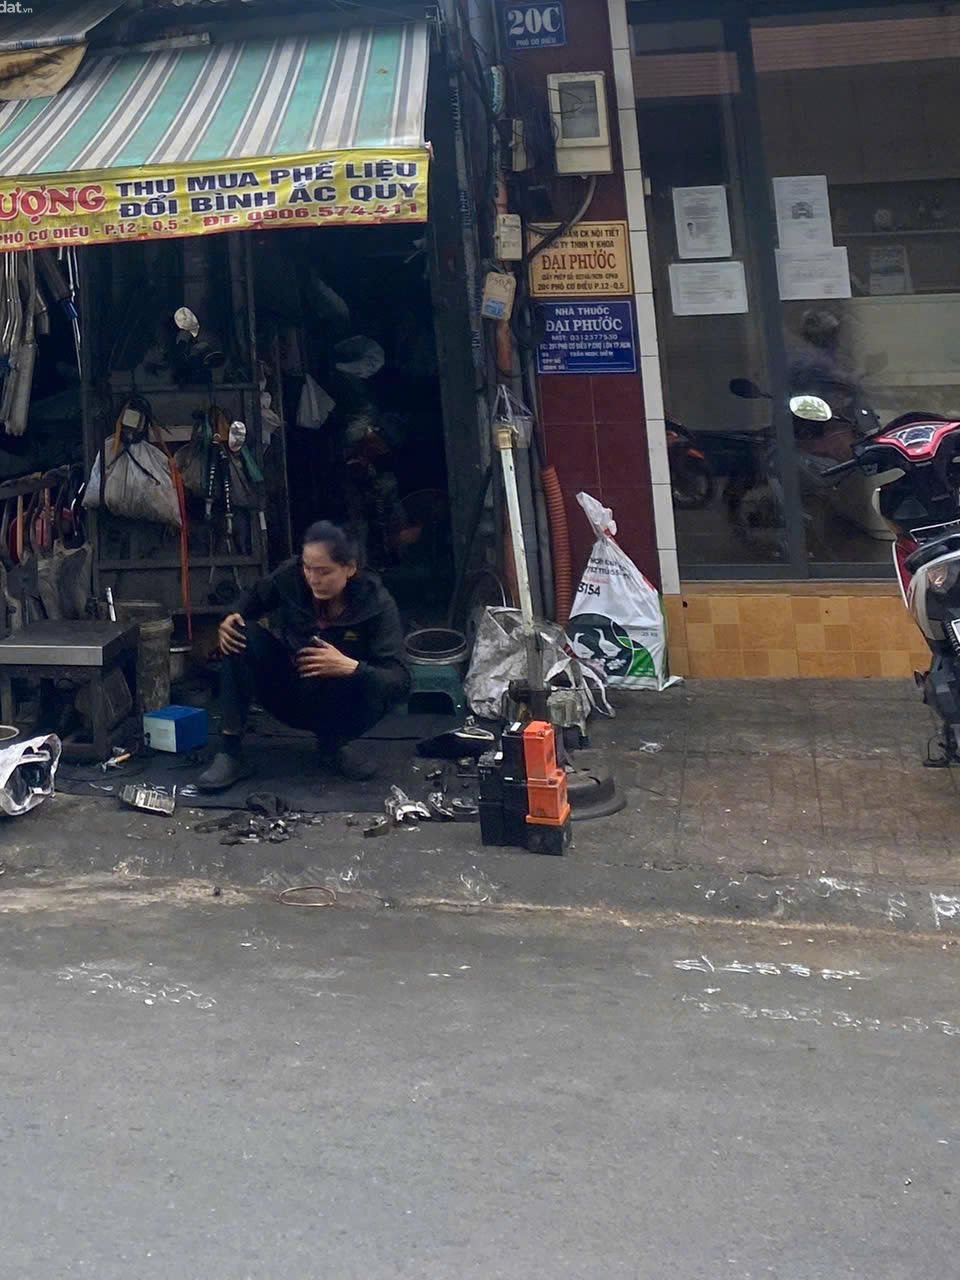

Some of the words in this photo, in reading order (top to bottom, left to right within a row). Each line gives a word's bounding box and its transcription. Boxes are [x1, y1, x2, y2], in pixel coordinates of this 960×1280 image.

[508, 6, 561, 35] 20C
[116, 178, 176, 197] THU
[187, 171, 260, 192] MUA
[270, 160, 337, 185] PHẾ
[345, 160, 417, 182] LIỆU
[191, 192, 276, 213] BÌNH
[287, 182, 337, 204] ẮC
[349, 183, 420, 201] QUY
[104, 222, 137, 235] P.12
[542, 254, 567, 273] ĐẠI
[569, 249, 616, 270] PHƯỚC
[545, 320, 570, 334] ĐẠI
[572, 316, 623, 332] PHƯỚC
